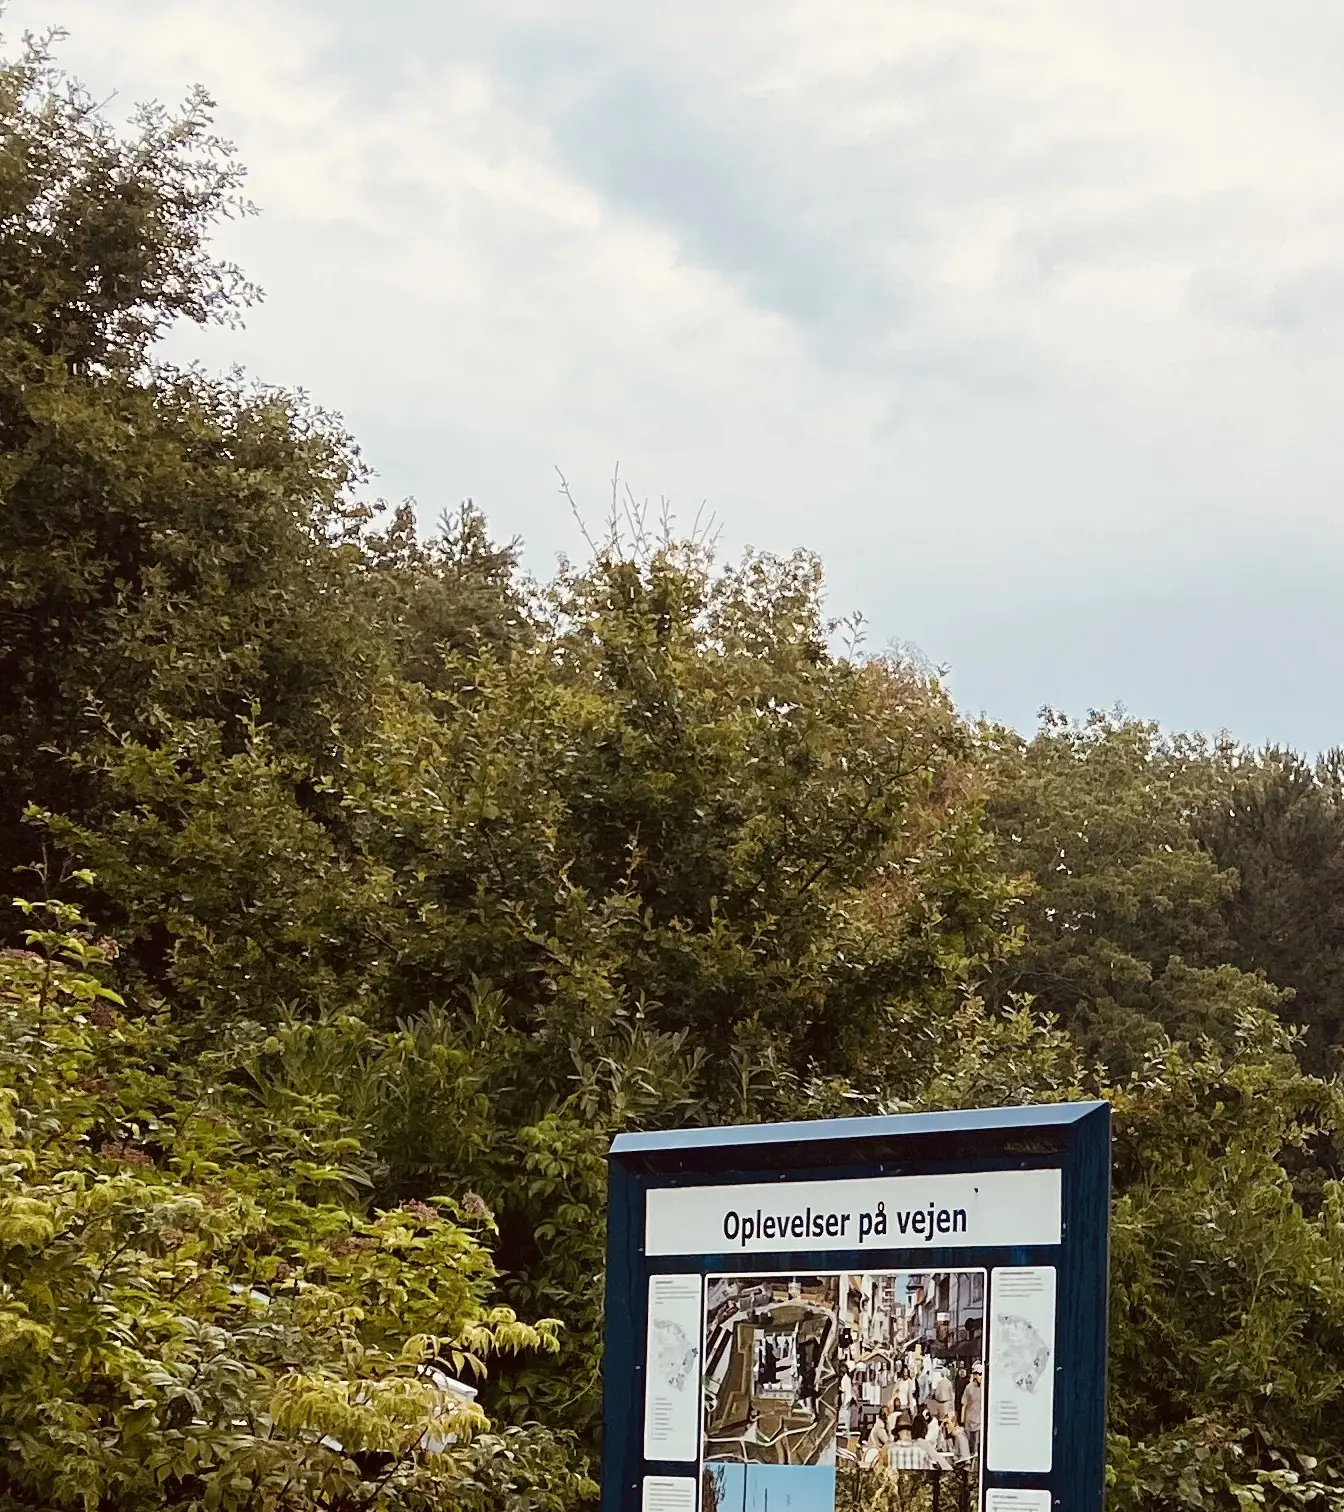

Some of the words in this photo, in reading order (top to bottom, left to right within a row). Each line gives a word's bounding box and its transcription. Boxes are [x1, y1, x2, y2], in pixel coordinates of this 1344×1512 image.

[723, 1207, 851, 1246] Oplevelser
[858, 1201, 887, 1243] på
[896, 1201, 967, 1242] vejen
